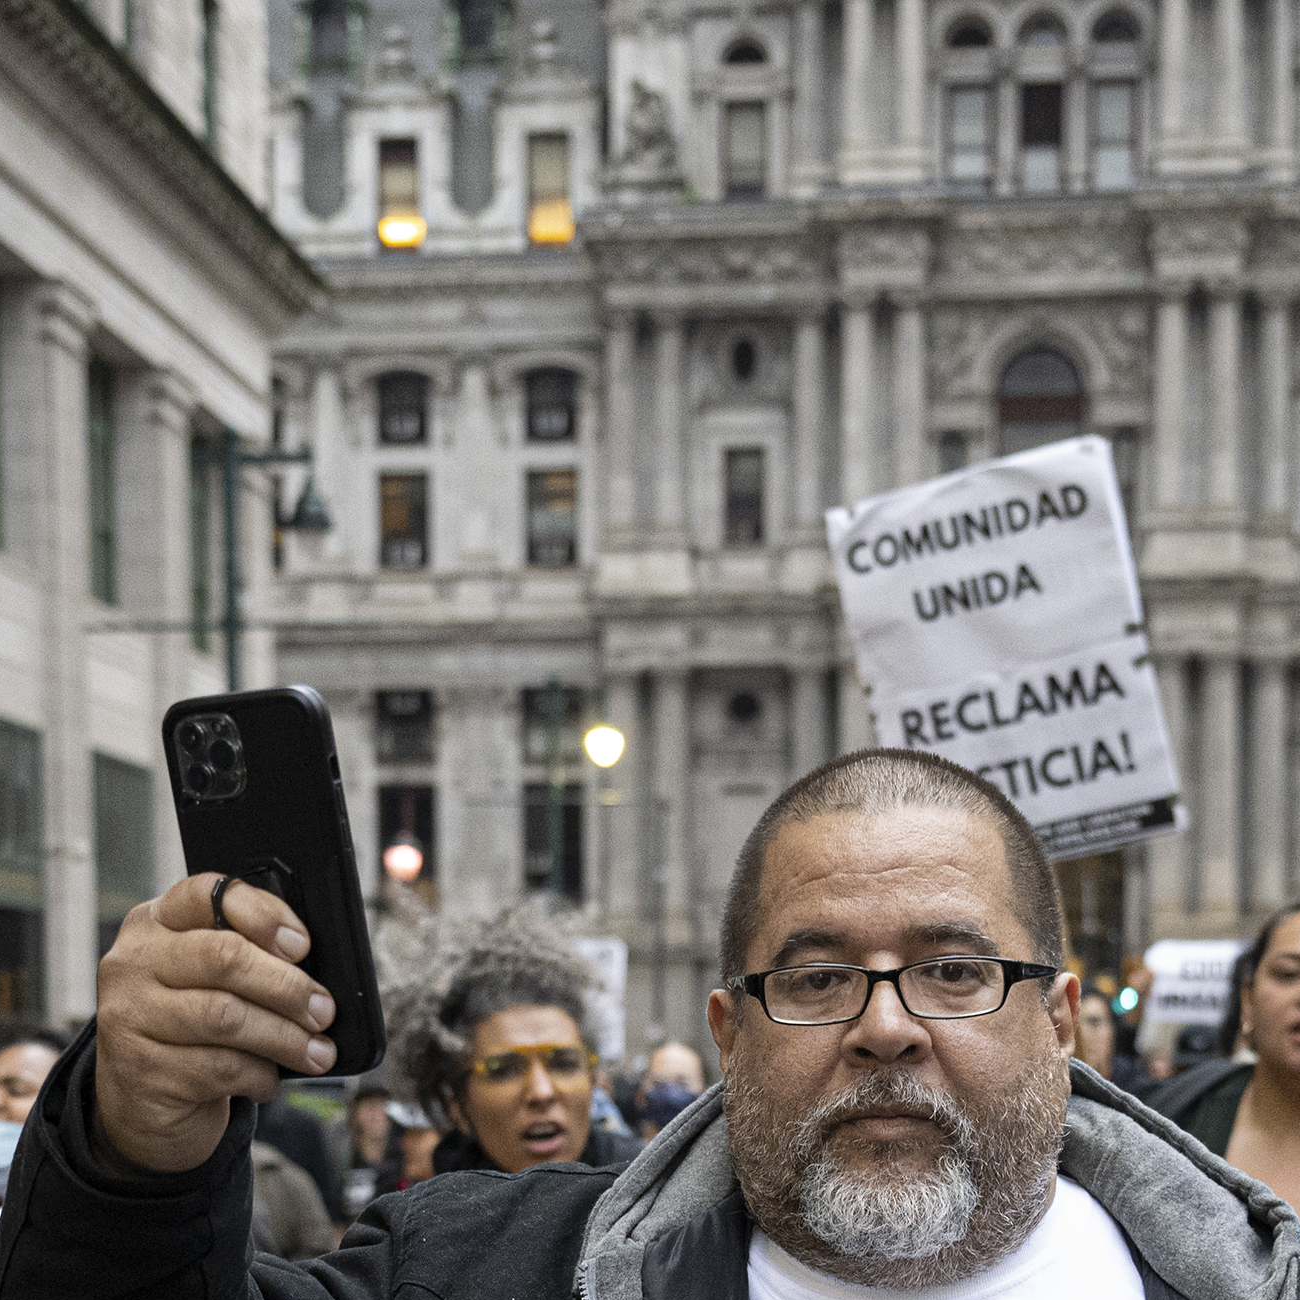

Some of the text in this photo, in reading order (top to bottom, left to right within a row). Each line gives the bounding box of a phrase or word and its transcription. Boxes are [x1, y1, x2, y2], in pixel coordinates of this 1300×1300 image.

[846, 483, 1088, 574] COMUNIDAD
[911, 563, 1043, 623] UNIDA
[899, 659, 1126, 750] RECLAMA
[976, 729, 1137, 798] TICIA!
